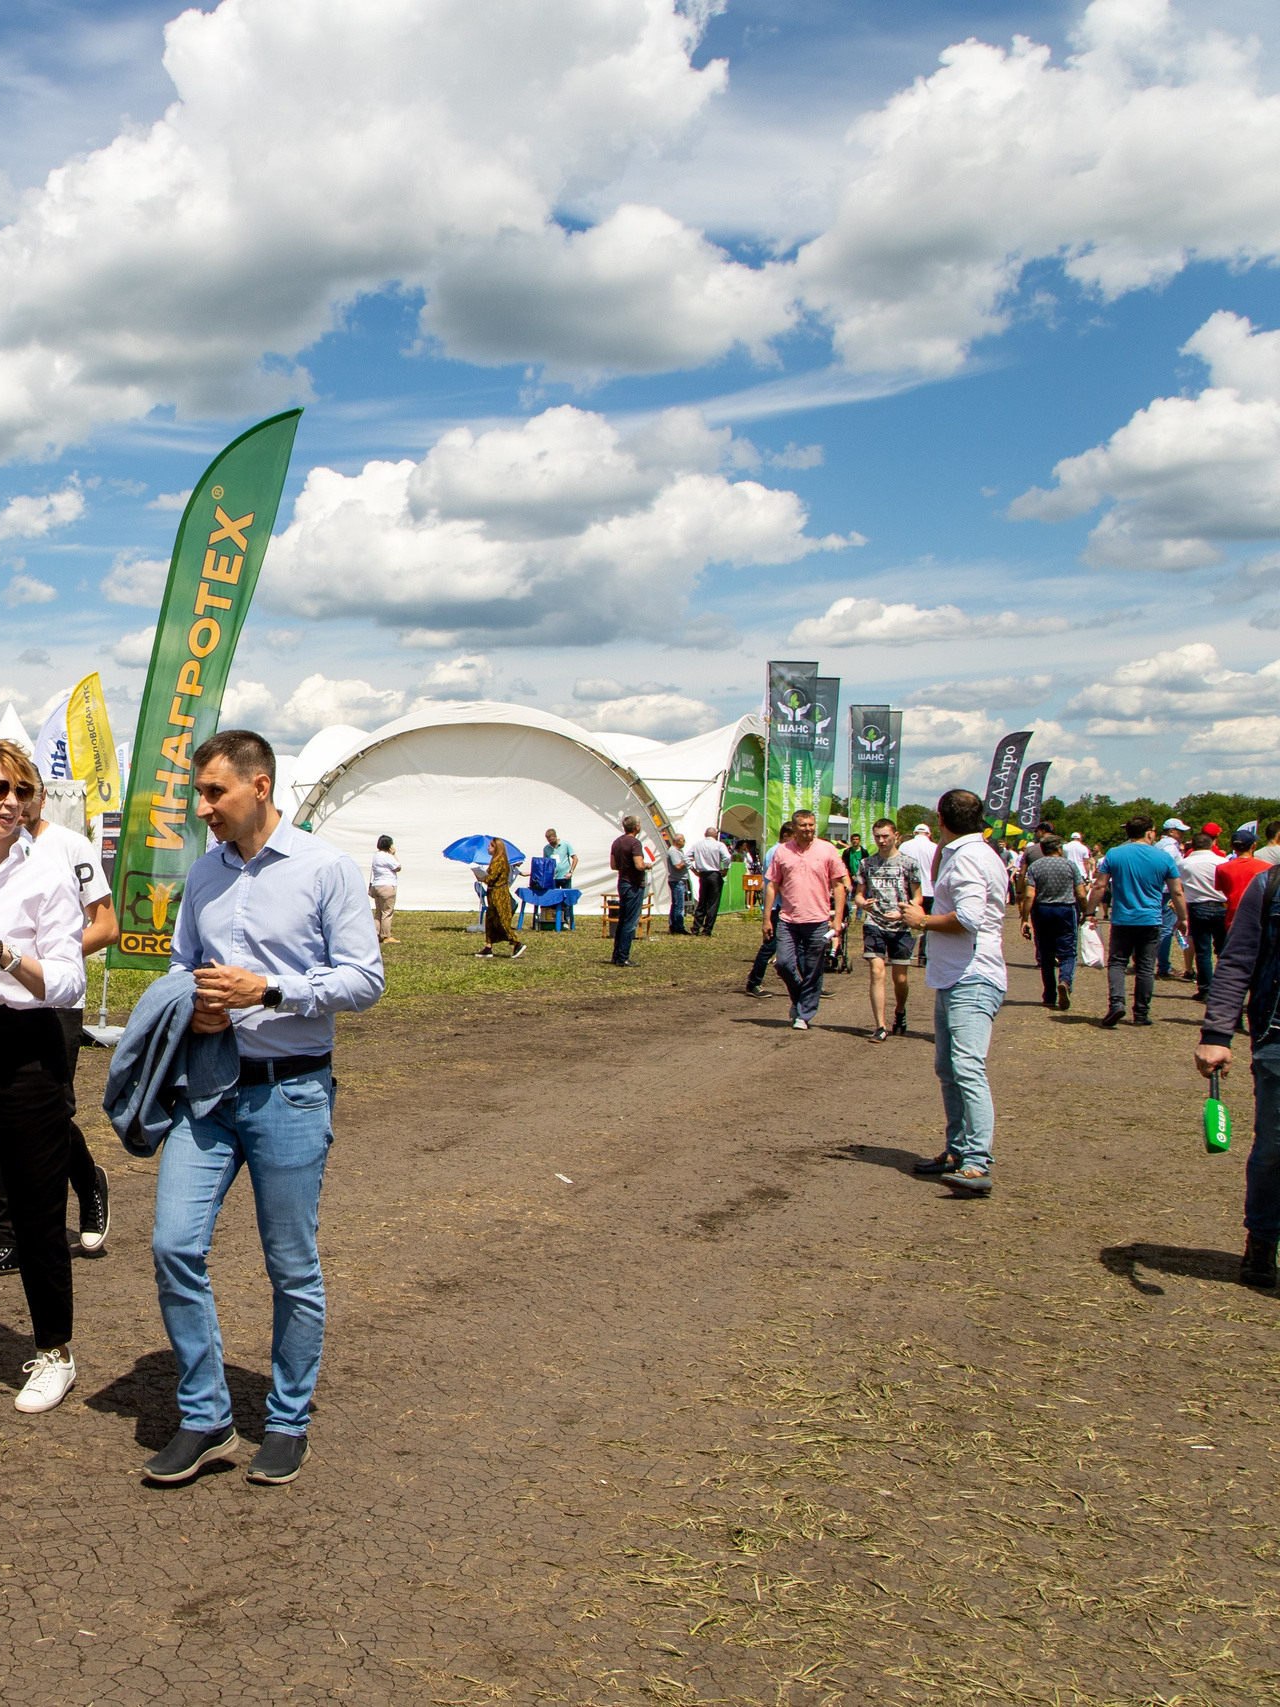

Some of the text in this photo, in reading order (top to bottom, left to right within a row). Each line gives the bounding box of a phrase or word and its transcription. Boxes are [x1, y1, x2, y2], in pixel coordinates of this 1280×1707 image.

[145, 504, 255, 851] ИНАГРОТЕХ
[85, 706, 102, 772] ПАВЛОВСКАЯ
[777, 723, 809, 734] ШАНС
[51, 739, 67, 779] nta
[857, 753, 884, 761] ШАНС
[988, 745, 1018, 811] СД-Агро
[781, 764, 791, 812] растений
[869, 780, 878, 823] профессия
[1020, 772, 1041, 826] СД-Агро
[123, 935, 173, 952] ORO
